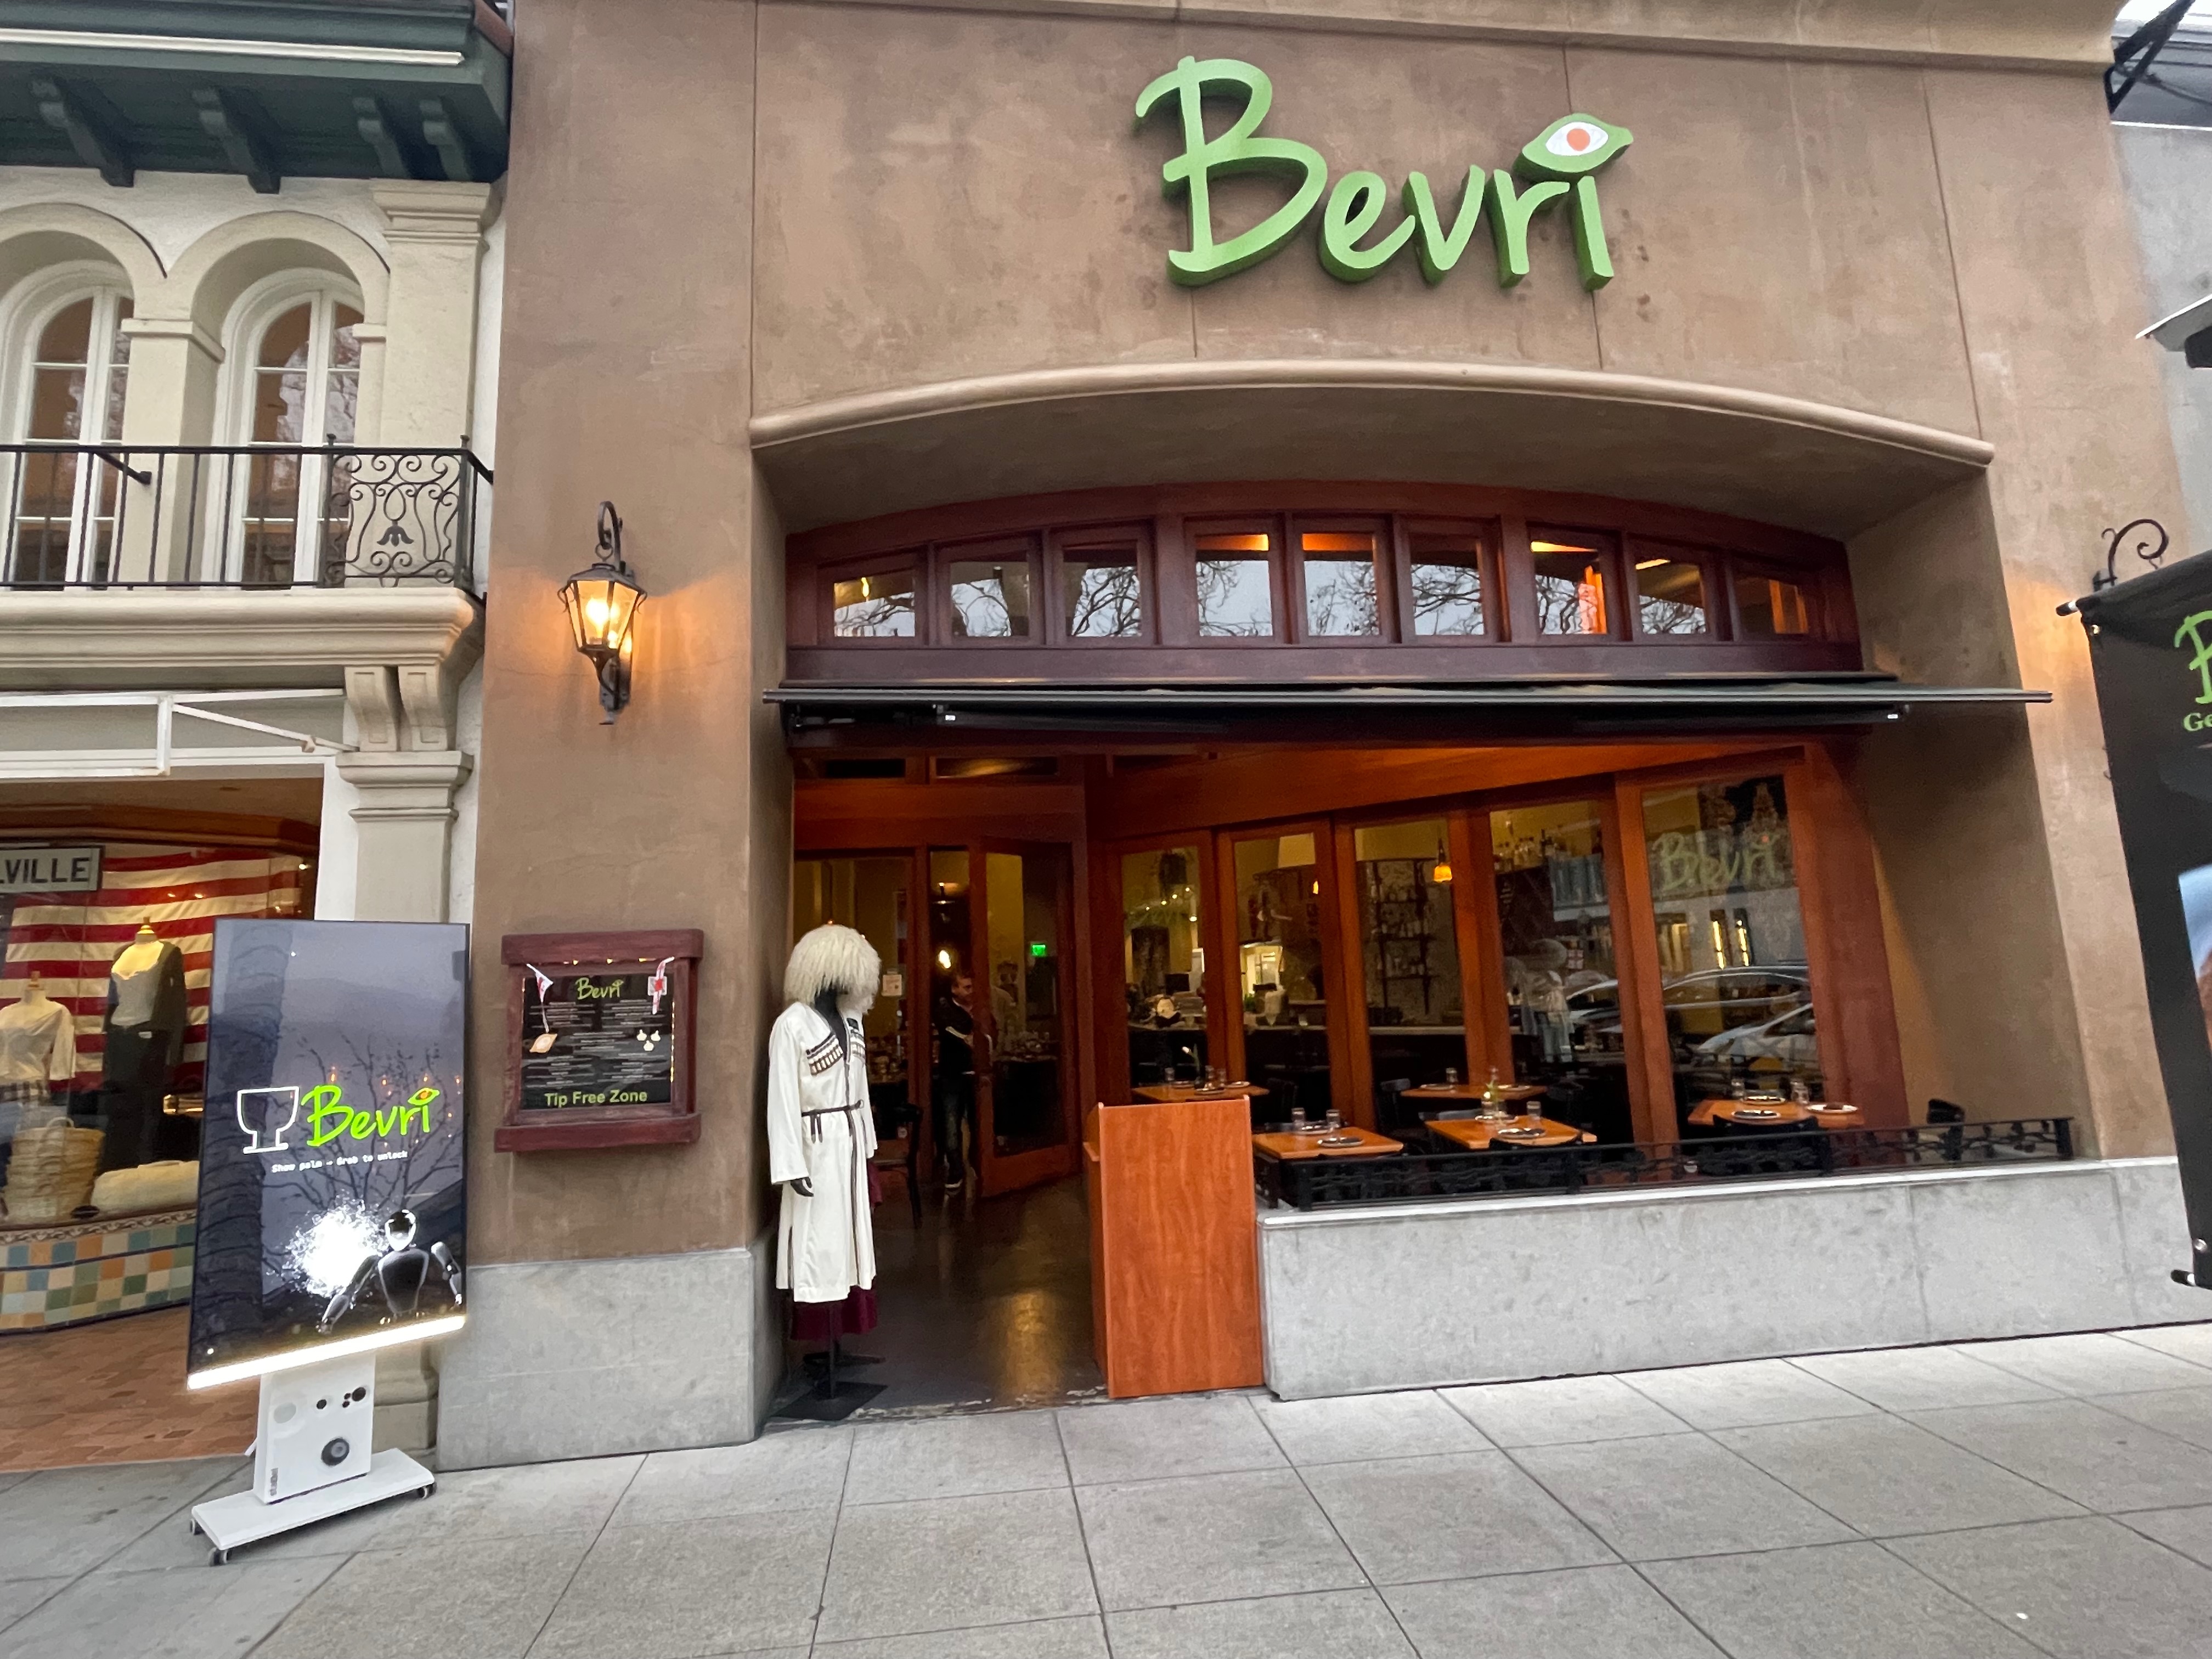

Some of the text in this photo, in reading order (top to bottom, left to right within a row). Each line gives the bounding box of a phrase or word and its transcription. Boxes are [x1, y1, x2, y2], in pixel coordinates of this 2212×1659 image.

[1135, 55, 1634, 291] Bevri
[0, 857, 90, 884] VILLE
[574, 977, 624, 1000] Bevri
[544, 1089, 648, 1108] Tip Free Zone
[301, 1085, 440, 1147] Bevri
[362, 1154, 374, 1163] to
